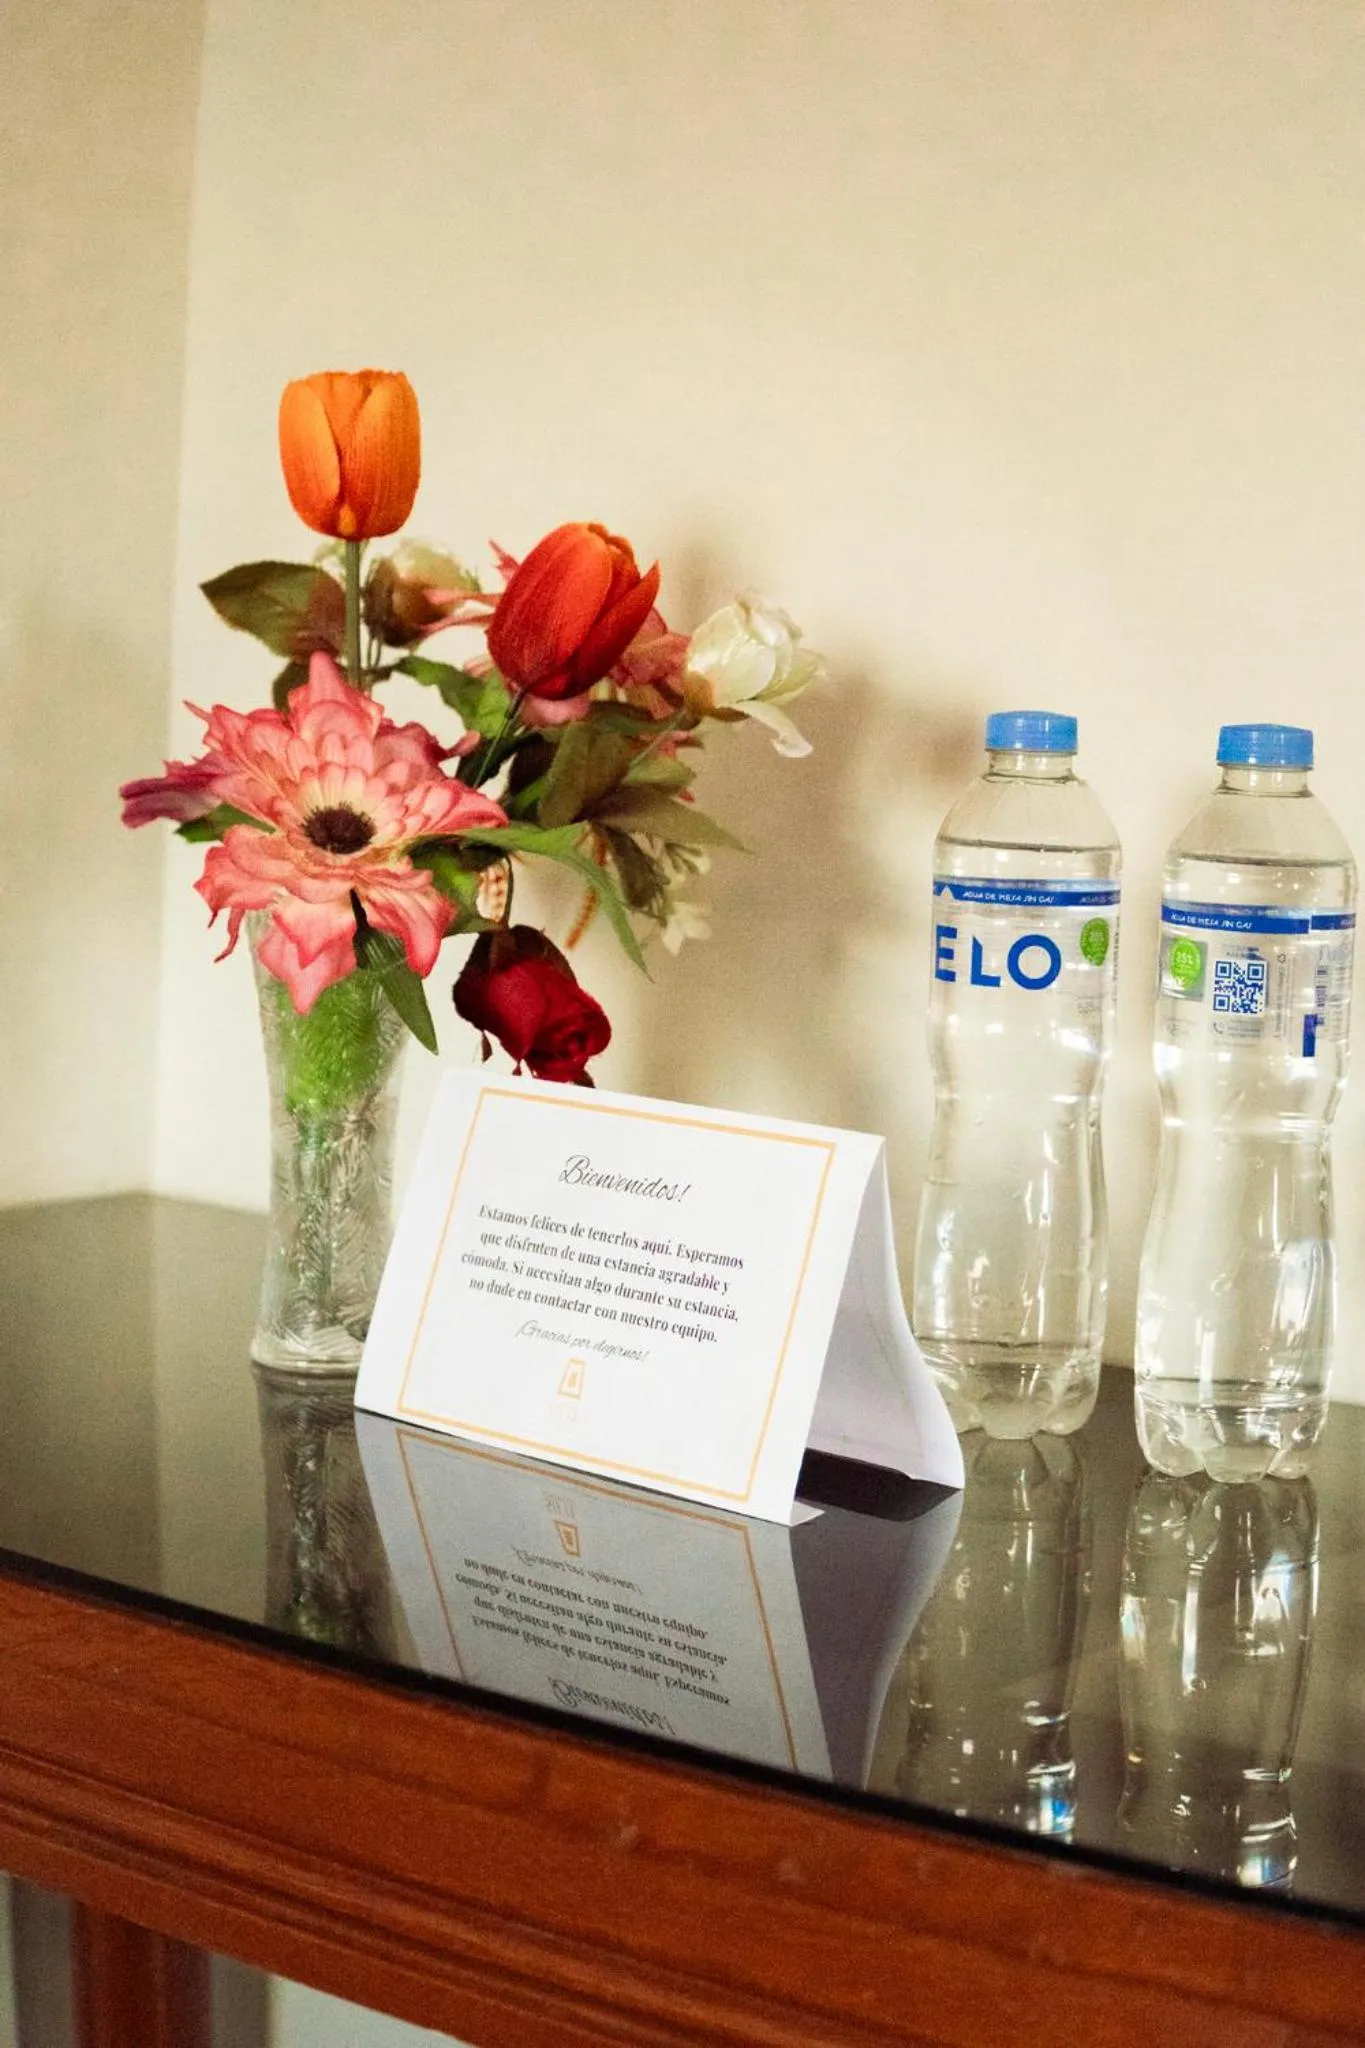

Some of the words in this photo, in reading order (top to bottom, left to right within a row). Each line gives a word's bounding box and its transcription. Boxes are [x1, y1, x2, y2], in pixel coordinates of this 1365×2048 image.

[962, 891, 983, 899] AGUA
[985, 892, 996, 900] DE
[999, 893, 1021, 902] MESA
[1198, 917, 1218, 927] MESA
[558, 1154, 692, 1203] Bienvenidos!
[479, 1205, 528, 1226] Estamos
[531, 1214, 568, 1234] felices
[570, 1222, 586, 1238] de
[588, 1227, 639, 1249] tenerlos
[677, 1244, 744, 1270] Esperamos
[480, 1233, 503, 1246] que
[505, 1235, 558, 1257] disfruten
[560, 1245, 576, 1262] de
[578, 1252, 602, 1267] una
[604, 1258, 656, 1278] estancia
[659, 1270, 721, 1291] agradable
[719, 1281, 729, 1296] y
[461, 1254, 508, 1272] cómoda.
[512, 1261, 525, 1276] Si
[526, 1267, 583, 1288] necesitan
[584, 1276, 613, 1294] algo
[614, 1283, 665, 1305] durante
[667, 1297, 683, 1310] su
[685, 1301, 739, 1322] estancia,
[469, 1279, 485, 1291] no
[487, 1280, 516, 1298] dude
[517, 1290, 532, 1302] en
[534, 1294, 592, 1315] contactar
[594, 1307, 618, 1321] con
[620, 1312, 669, 1332] nuestro
[671, 1324, 718, 1343] equipo.
